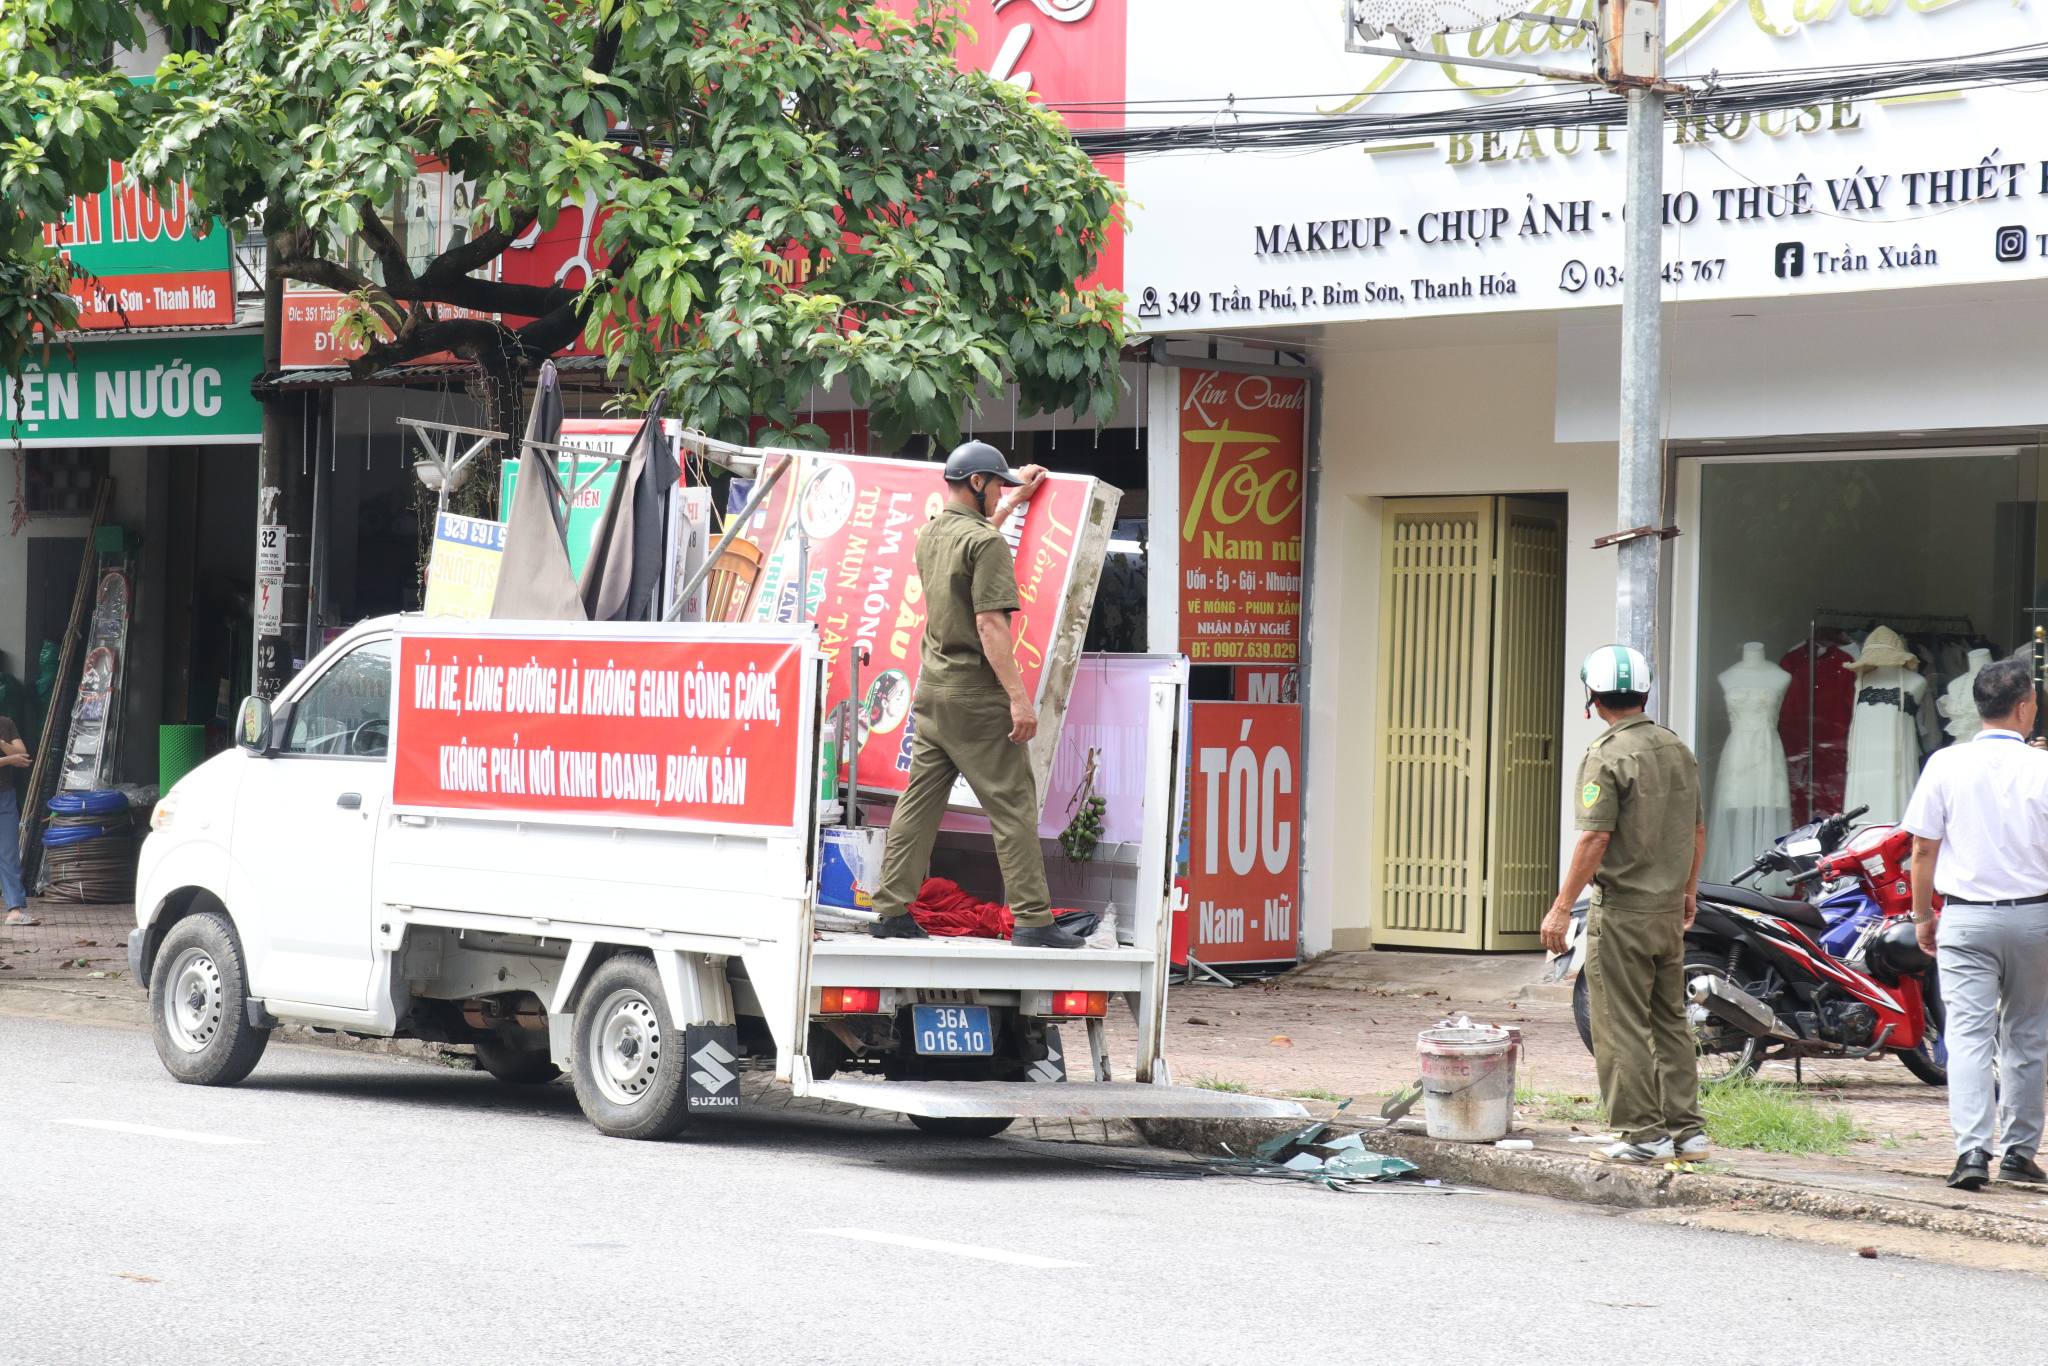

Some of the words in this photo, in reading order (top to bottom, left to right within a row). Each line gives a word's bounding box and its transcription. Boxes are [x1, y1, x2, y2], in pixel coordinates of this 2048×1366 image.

[1445, 123, 1613, 165] BEAUT
[1254, 216, 1391, 256] MAKEUP
[1417, 207, 1509, 248] CHỤP
[1518, 193, 1593, 237] ẢNH
[1712, 172, 1815, 222] THUÊ
[1825, 165, 1889, 212] VÁY
[1902, 147, 2025, 206] THIẾT
[1691, 258, 1726, 282] 767
[1813, 242, 1868, 275] Trần
[1878, 244, 1938, 270] Xuân
[120, 286, 144, 312] Sơn
[153, 287, 190, 311] Thanh
[192, 284, 216, 310] Hóa
[1166, 291, 1201, 314] 349
[1209, 284, 1251, 313] Trần
[1301, 287, 1317, 306] P.
[1411, 276, 1473, 301] Thanh
[1479, 273, 1517, 297] Hóa
[305, 306, 318, 321] 351
[0, 362, 79, 432] IỆN
[95, 358, 222, 420] NƯỚC
[1183, 370, 1228, 427] Kim
[1235, 375, 1304, 411] Oanh
[1182, 418, 1302, 542] Tóc
[847, 486, 882, 529] TRỊ
[877, 491, 913, 555] LÀM
[261, 530, 276, 548] 32
[444, 517, 469, 540] 626
[470, 522, 494, 545] 163
[836, 534, 869, 590] MỤN
[1019, 491, 1073, 604] Hồng
[1202, 531, 1262, 560] Nam
[1216, 566, 1229, 592] Ép
[1239, 571, 1256, 595] Gội
[1266, 571, 1301, 596] Nhuộm
[1188, 598, 1201, 614] VẼ
[1204, 598, 1236, 614] MÓNG
[1245, 601, 1274, 615] PHUN
[1197, 619, 1231, 636] NHẬN
[1191, 641, 1210, 658] ĐT:
[1213, 641, 1296, 658] 0907.639.029
[415, 649, 437, 709] VỈA
[464, 654, 504, 712] LÒNG
[506, 656, 557, 715] ĐƯỜNG
[559, 658, 579, 715] LÀ
[581, 660, 636, 717] KHÔNG
[639, 670, 679, 719] GIAN
[683, 661, 731, 720] CÔNG
[734, 662, 781, 731] CỘNG,
[439, 736, 487, 793] KHÔNG
[490, 732, 525, 795] PHẢI
[529, 749, 556, 796] NƠI
[559, 750, 598, 799] KINH
[601, 752, 661, 808] DOANH,
[664, 745, 708, 804] BUÔN
[711, 747, 747, 805] BÁN
[1200, 719, 1292, 875] TÓC
[1199, 901, 1244, 944] Nam
[1264, 893, 1291, 942] Nữ
[935, 1008, 969, 1029] 36A
[923, 1031, 984, 1052] 016.10
[690, 1096, 738, 1106] SUZUKI
